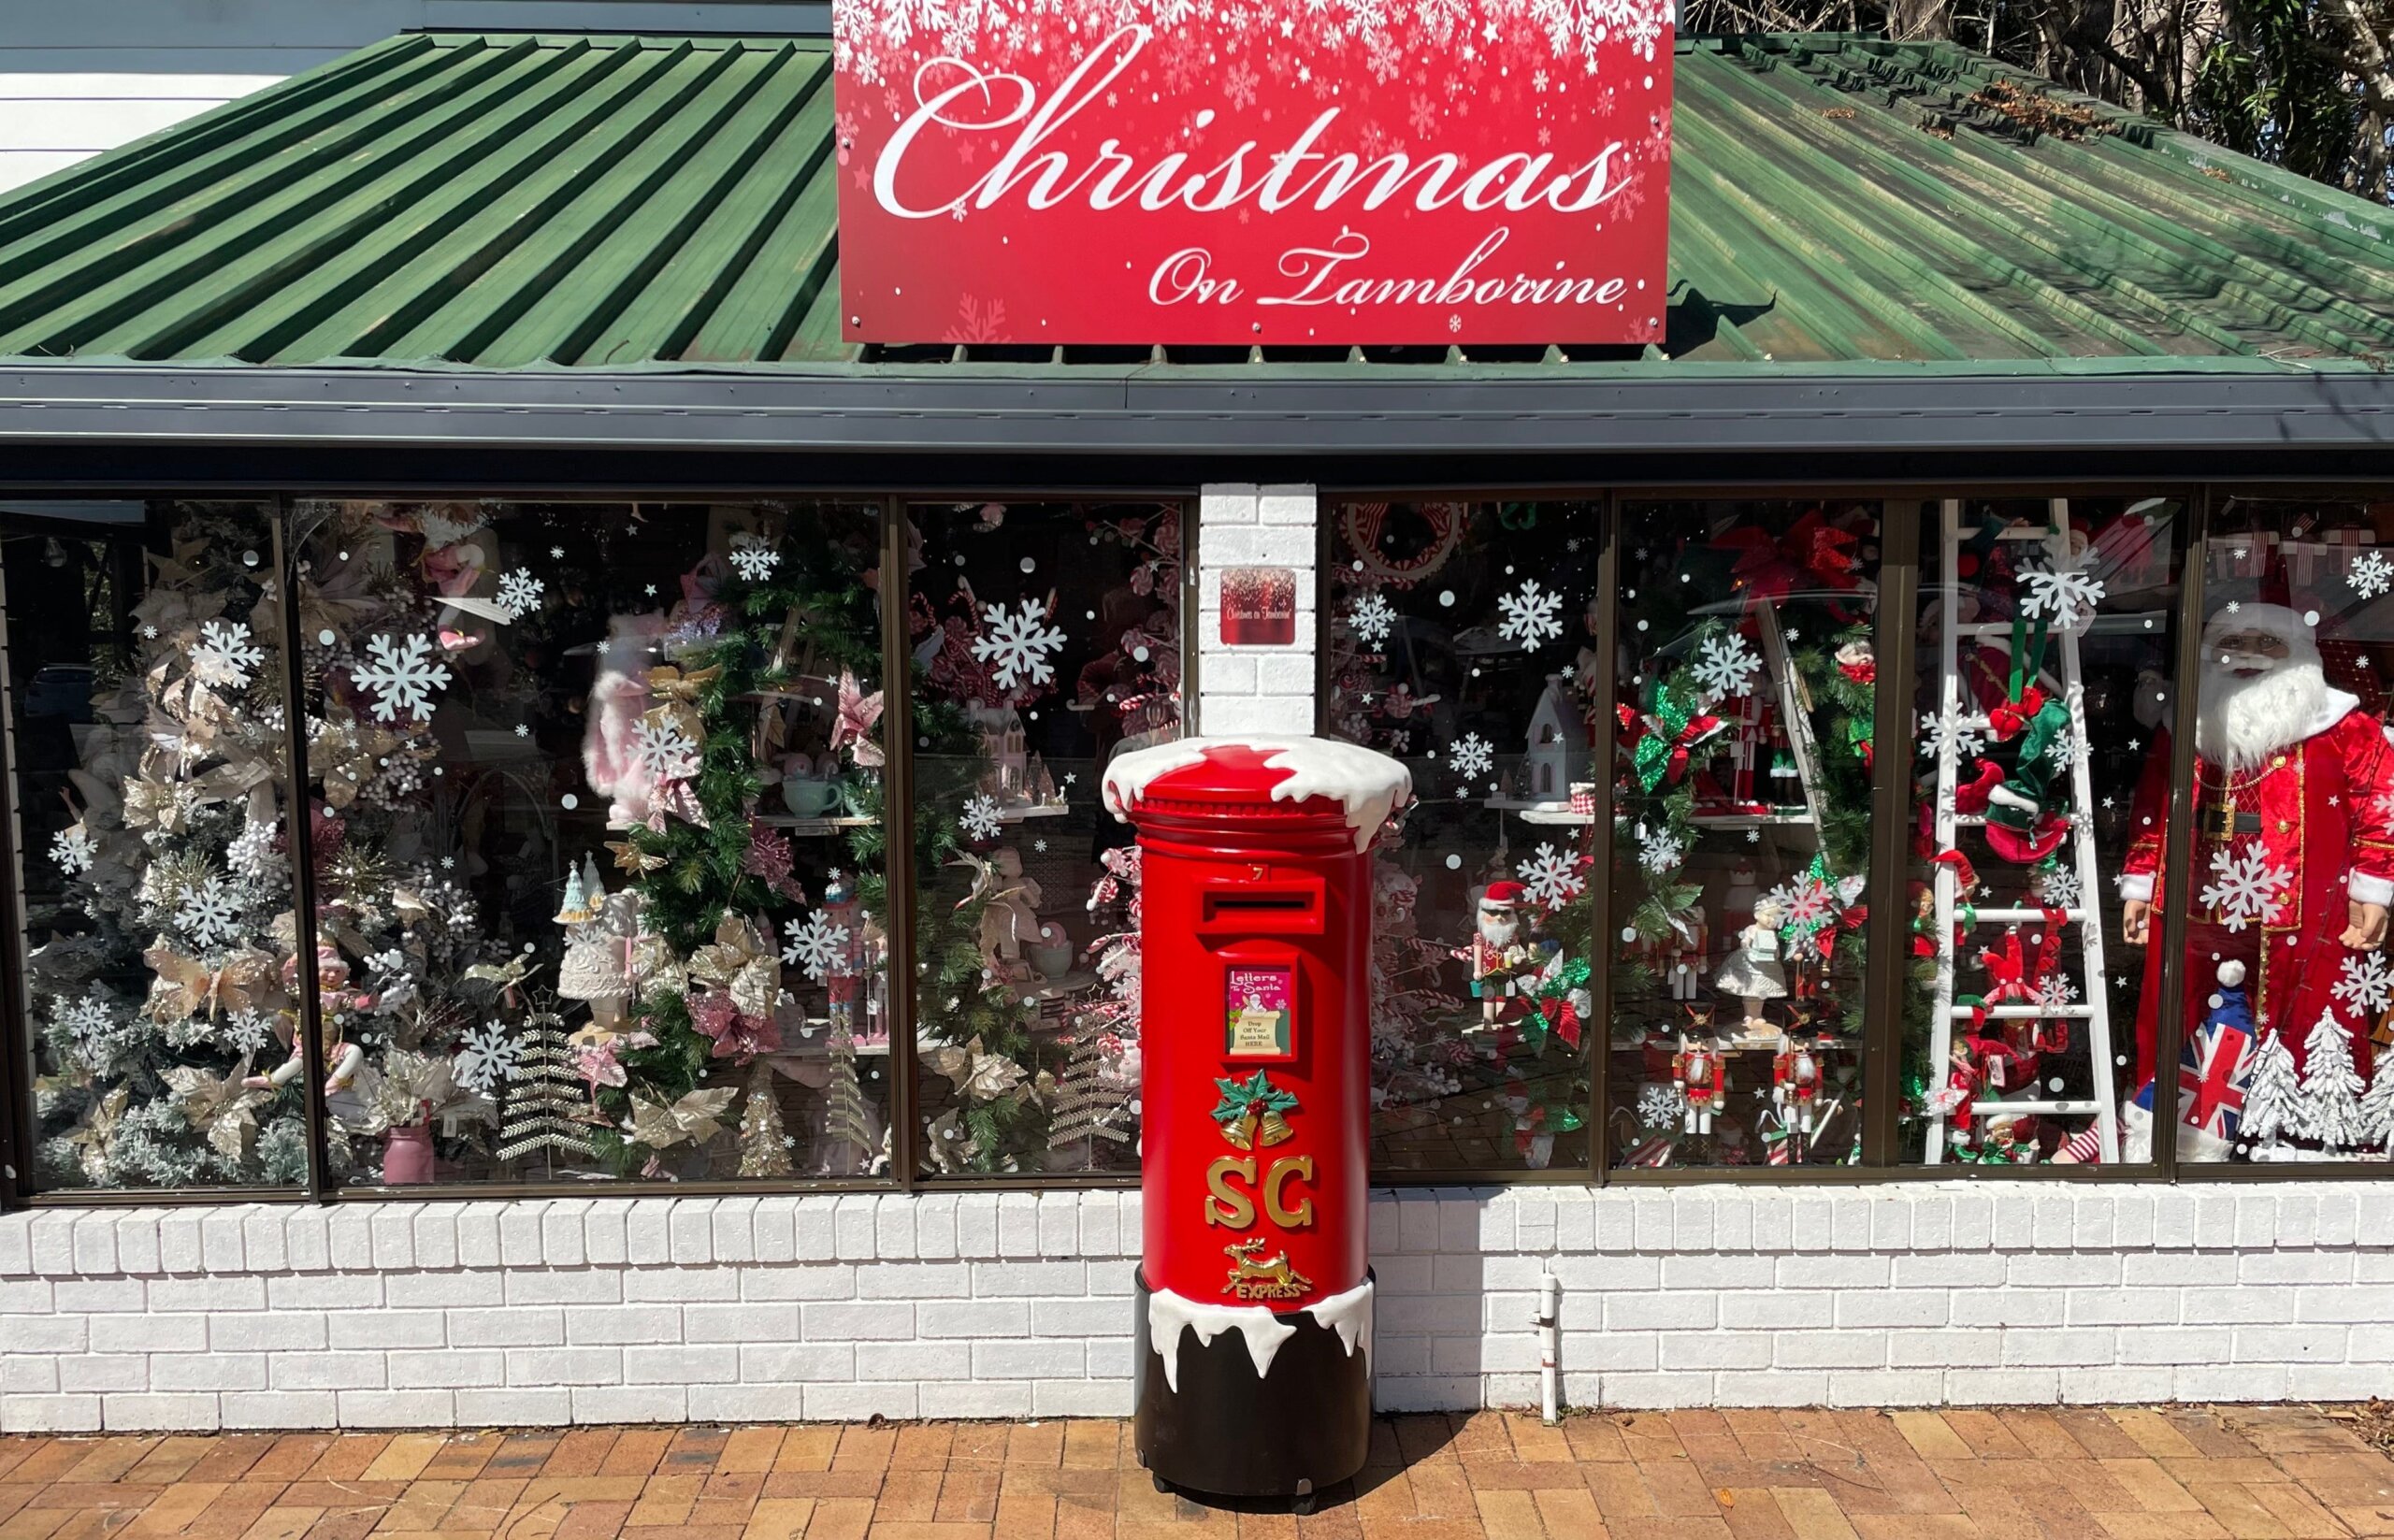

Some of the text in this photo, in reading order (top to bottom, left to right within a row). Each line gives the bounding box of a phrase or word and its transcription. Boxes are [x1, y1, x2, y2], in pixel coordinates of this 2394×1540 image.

[873, 24, 1632, 219] Christmas
[1148, 226, 1626, 307] On Tamborine
[1231, 971, 1276, 986] Letters
[1243, 982, 1281, 994] Santa
[1237, 1284, 1301, 1299] EXPRESS
